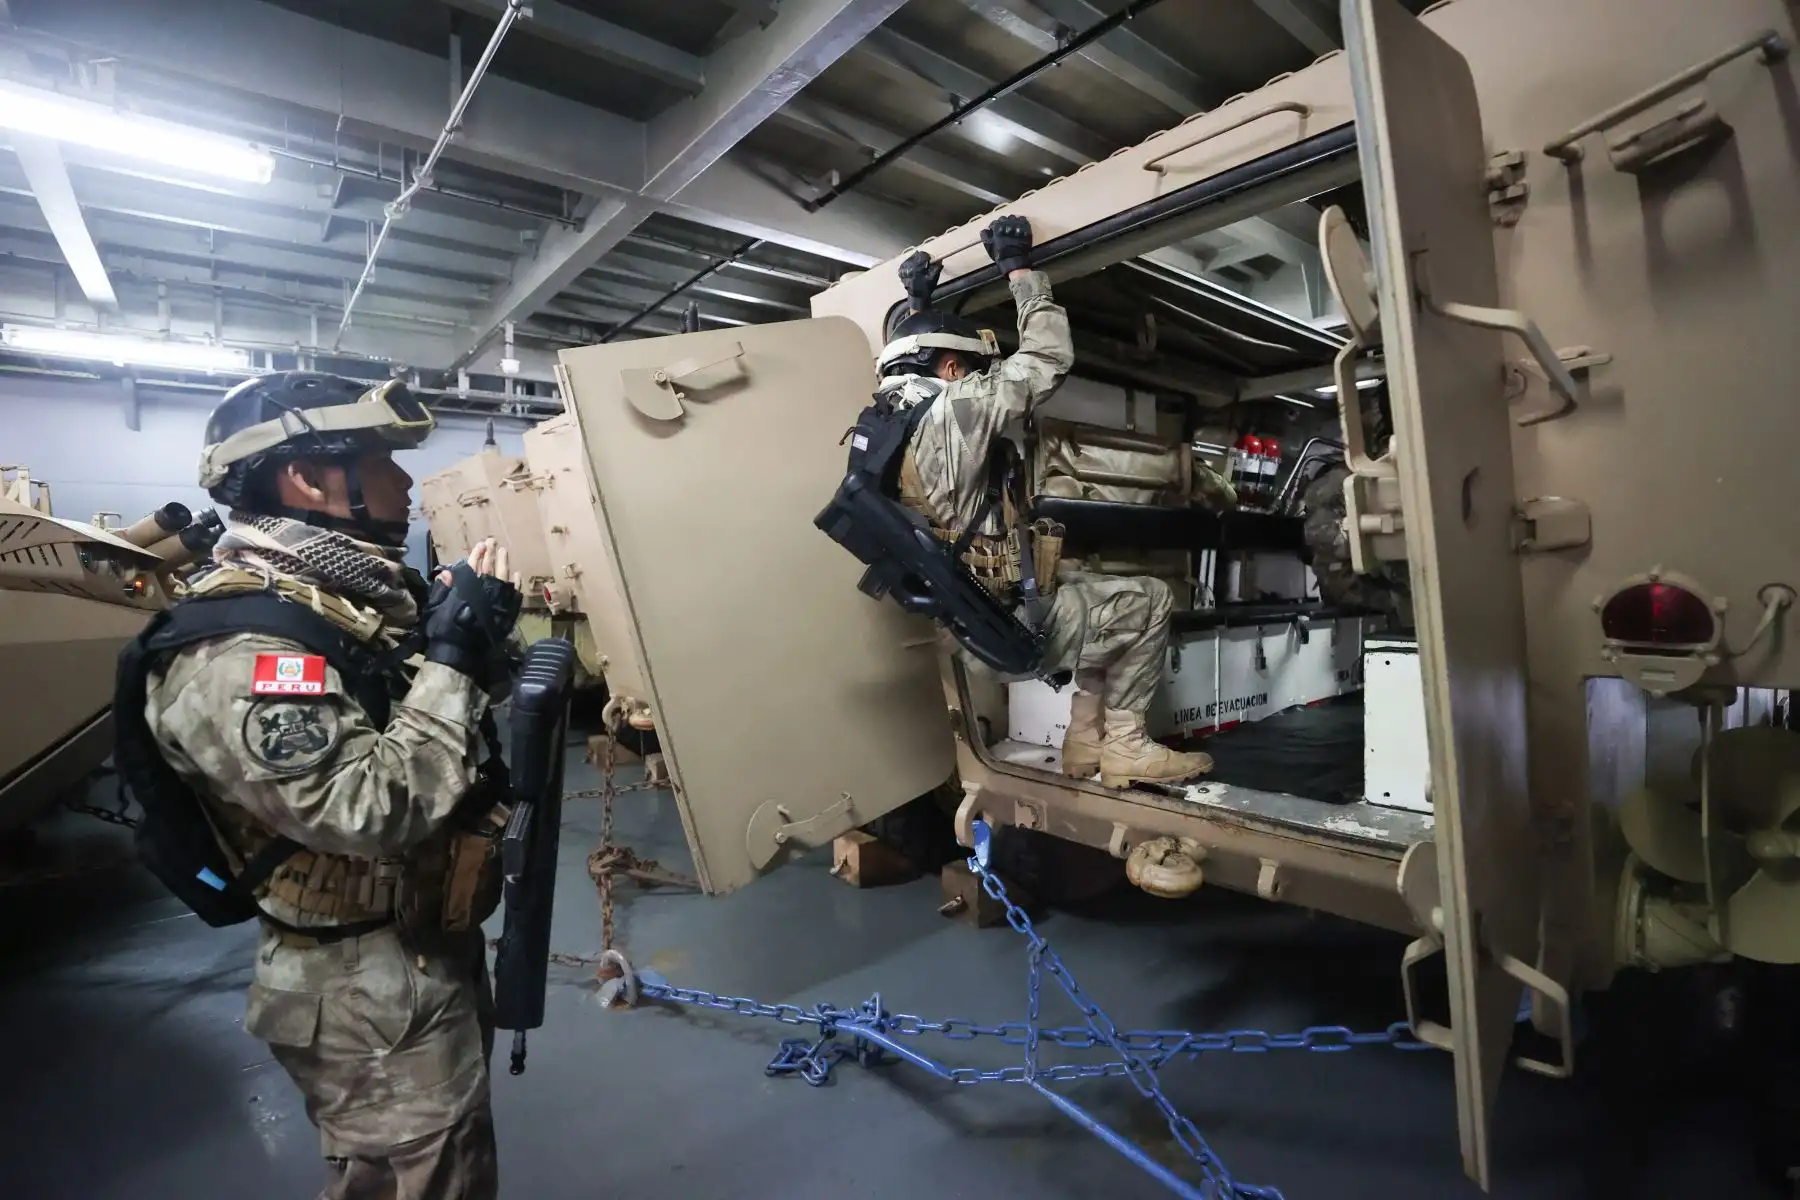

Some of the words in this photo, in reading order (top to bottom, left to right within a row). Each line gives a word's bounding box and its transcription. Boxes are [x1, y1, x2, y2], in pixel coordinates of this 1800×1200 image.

[262, 683, 316, 692] PERU
[1174, 706, 1202, 726] LINEA
[1205, 701, 1217, 717] DE
[1218, 692, 1268, 715] EVACUACION
